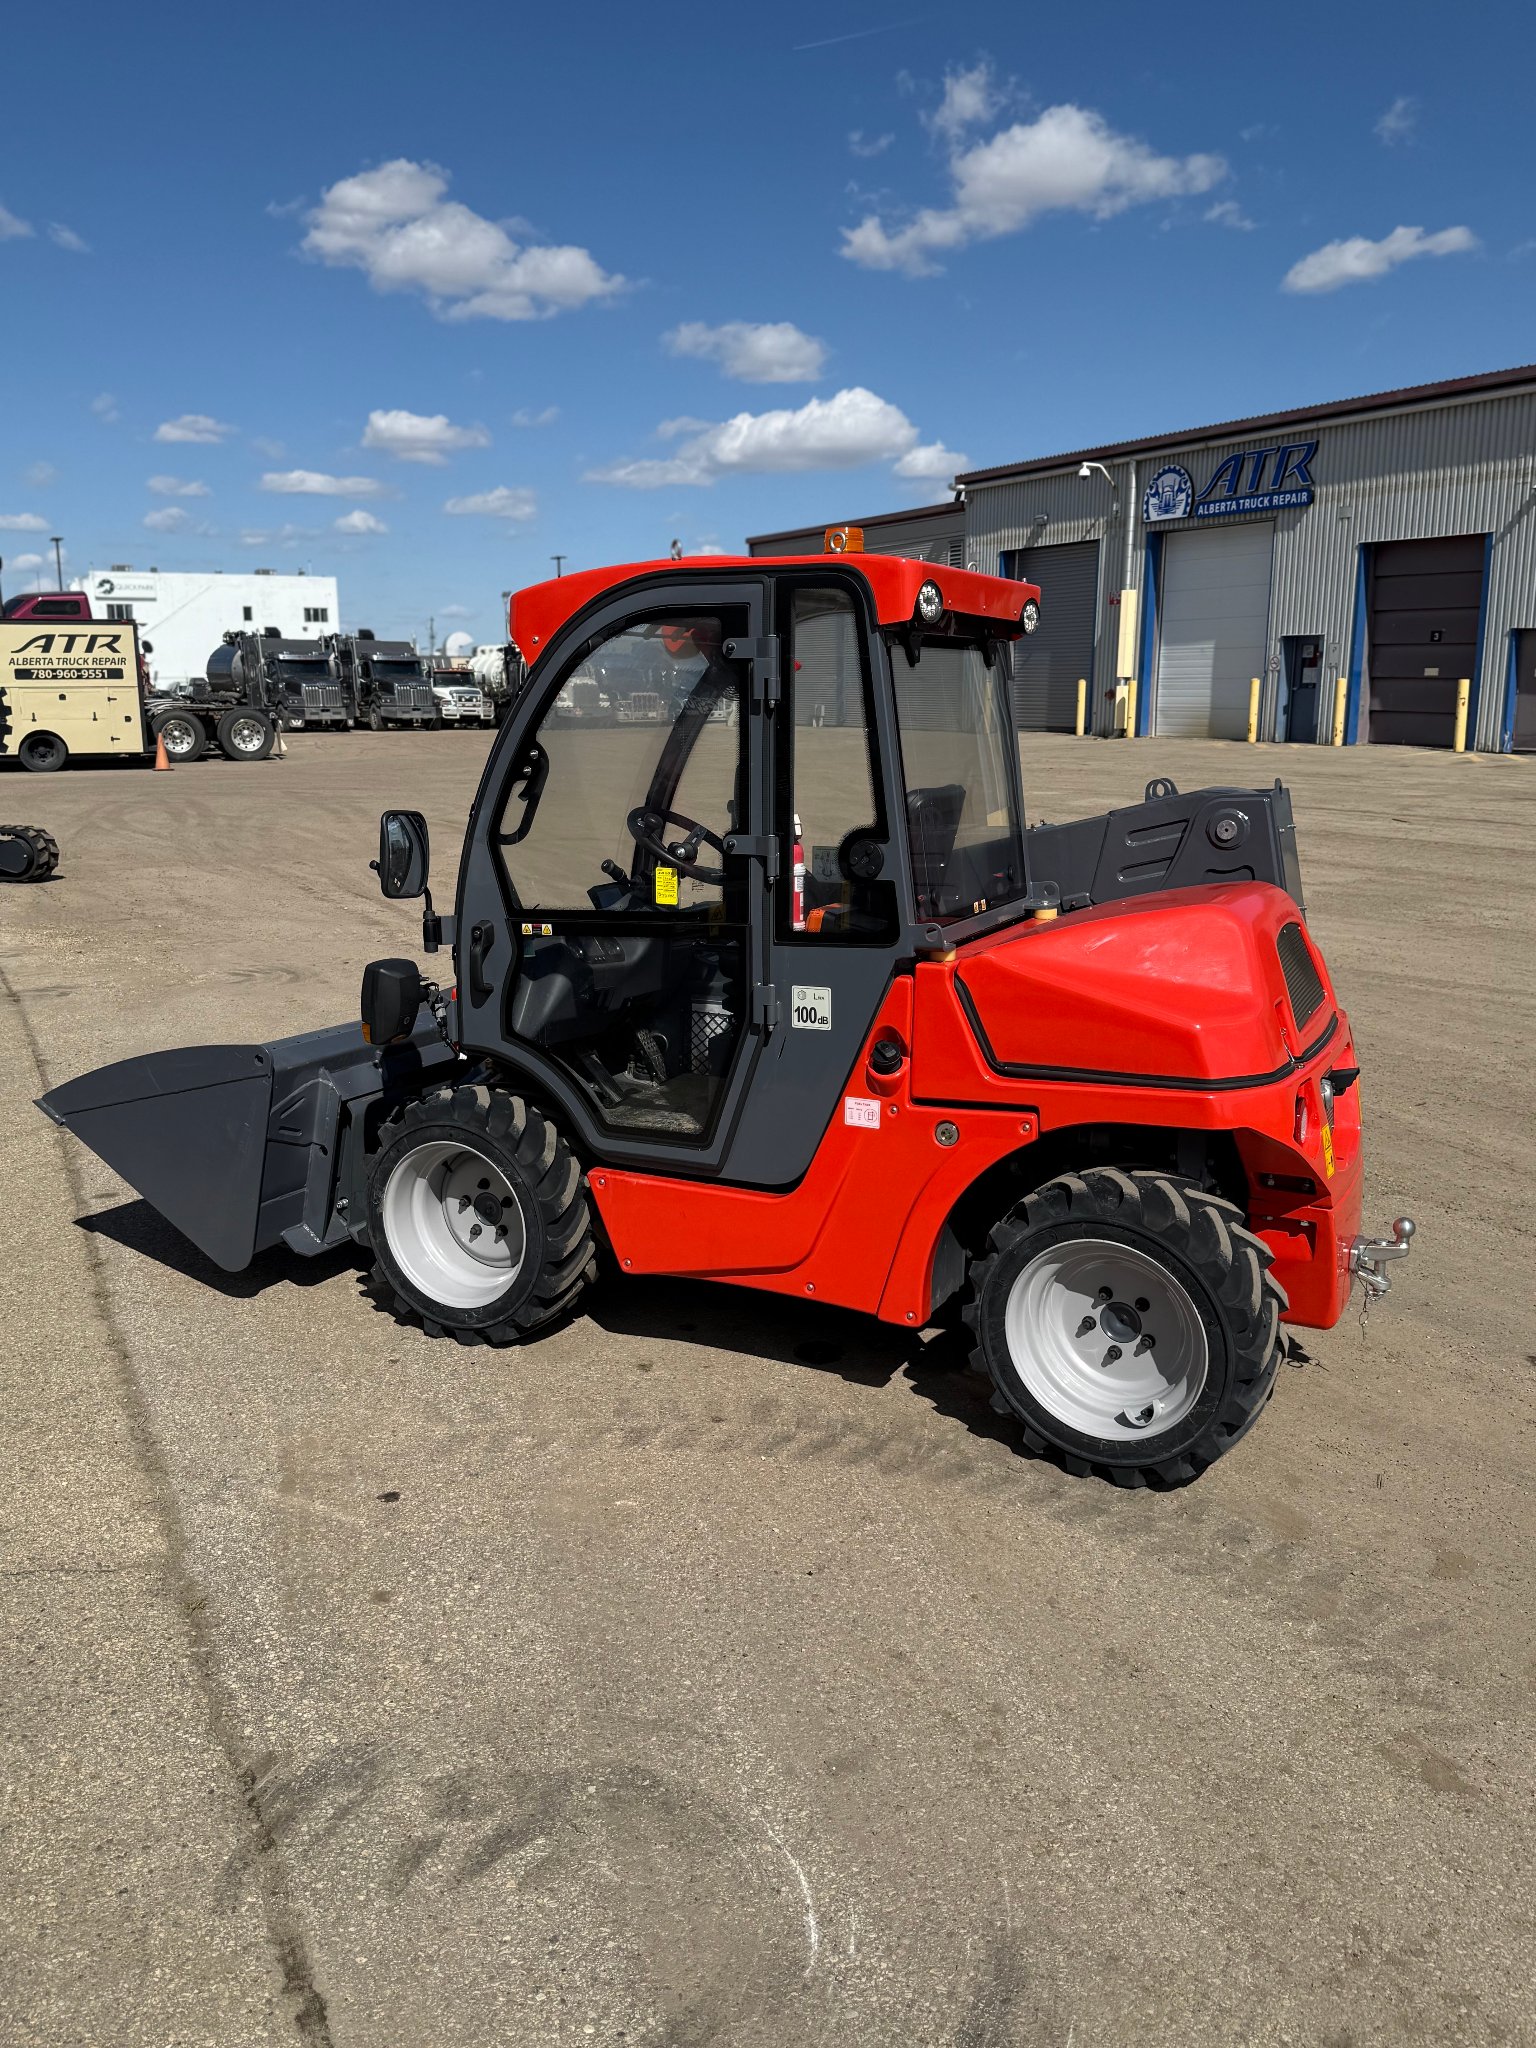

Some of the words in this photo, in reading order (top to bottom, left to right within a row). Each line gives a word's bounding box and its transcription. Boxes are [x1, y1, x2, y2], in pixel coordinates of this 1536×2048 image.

[1195, 441, 1318, 499] ATR
[1197, 500, 1237, 515] ALBERTA
[1239, 497, 1269, 509] TRUCK
[1272, 492, 1307, 506] REPAIR
[11, 634, 121, 653] ATR
[1433, 632, 1439, 640] 3
[8, 657, 54, 666] ALBERTA
[56, 657, 89, 666] TRUCK
[91, 657, 127, 666] REPAIR
[31, 669, 107, 678] 780-960-9551
[794, 1006, 817, 1023] 100
[817, 1016, 828, 1024] dB
